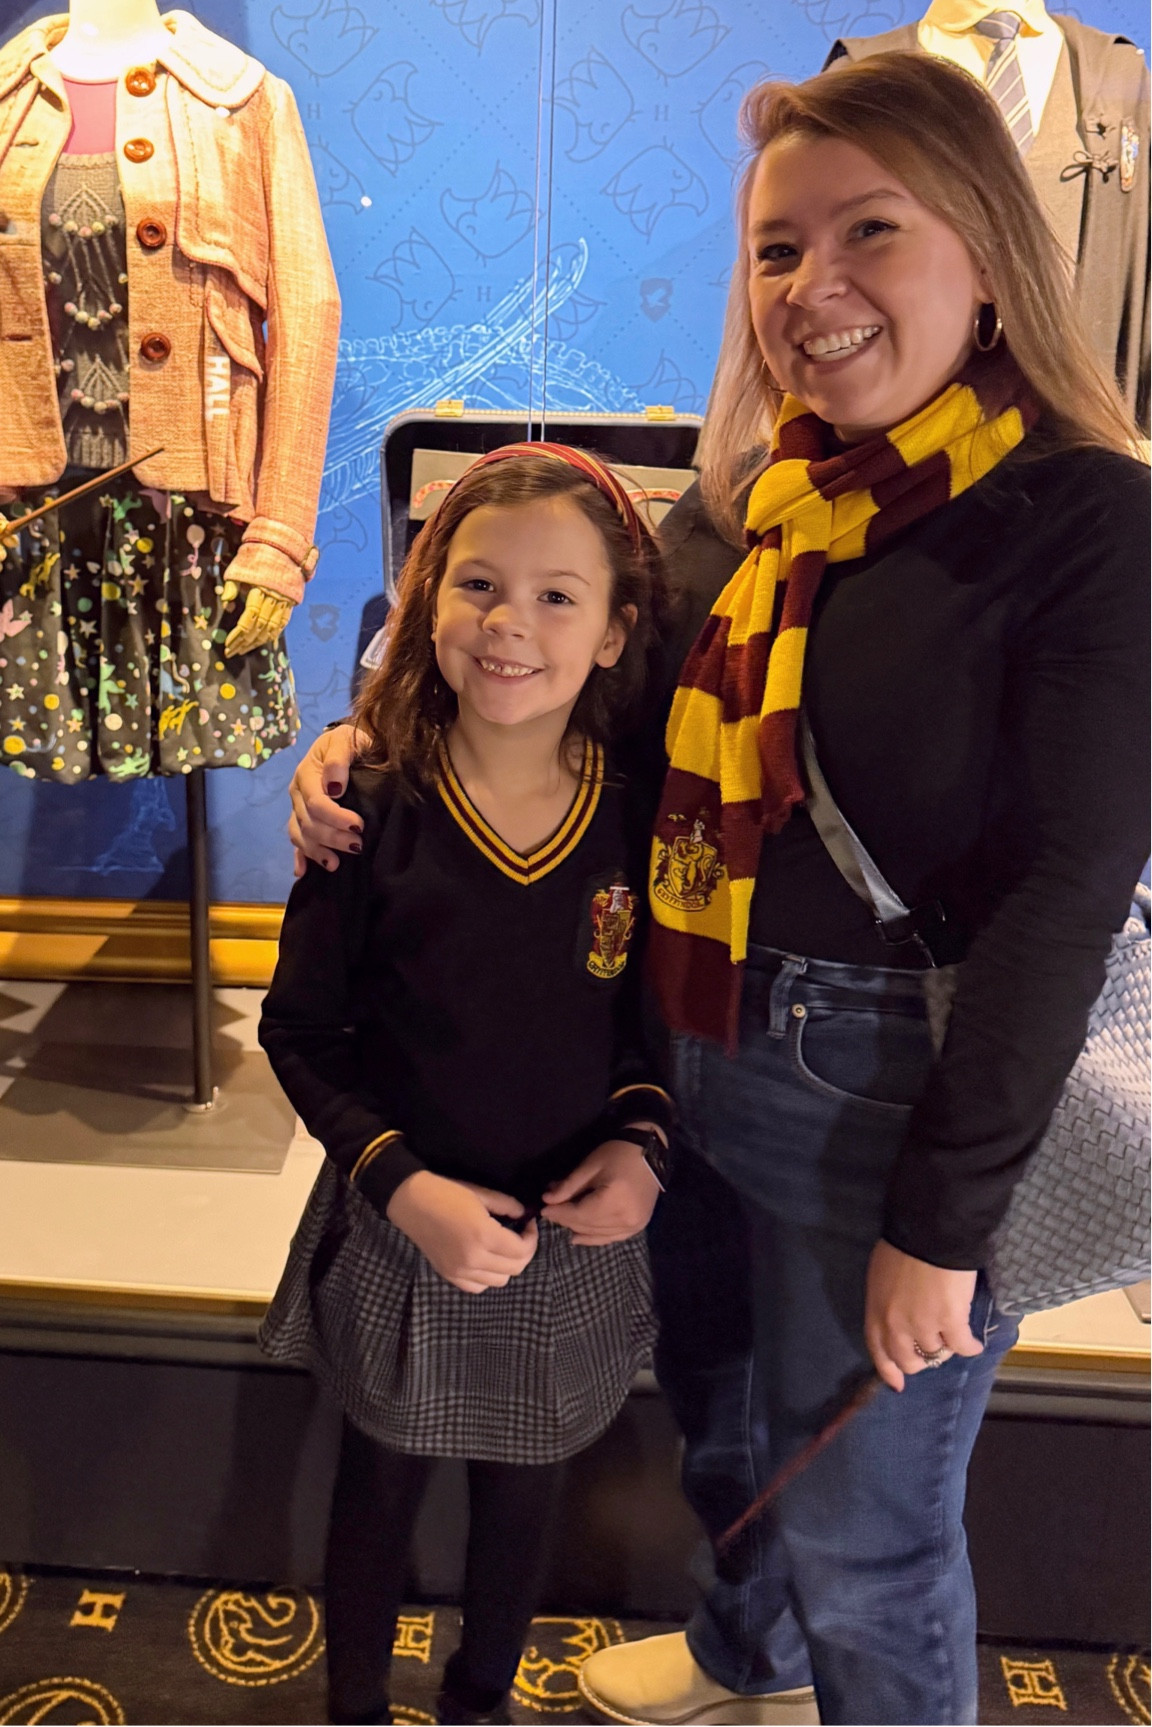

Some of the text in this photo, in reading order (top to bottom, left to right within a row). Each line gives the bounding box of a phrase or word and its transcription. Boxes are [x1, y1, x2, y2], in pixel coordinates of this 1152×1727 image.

[205, 356, 230, 421] HALL
[69, 1589, 126, 1632] H
[1000, 1656, 1067, 1711] H
